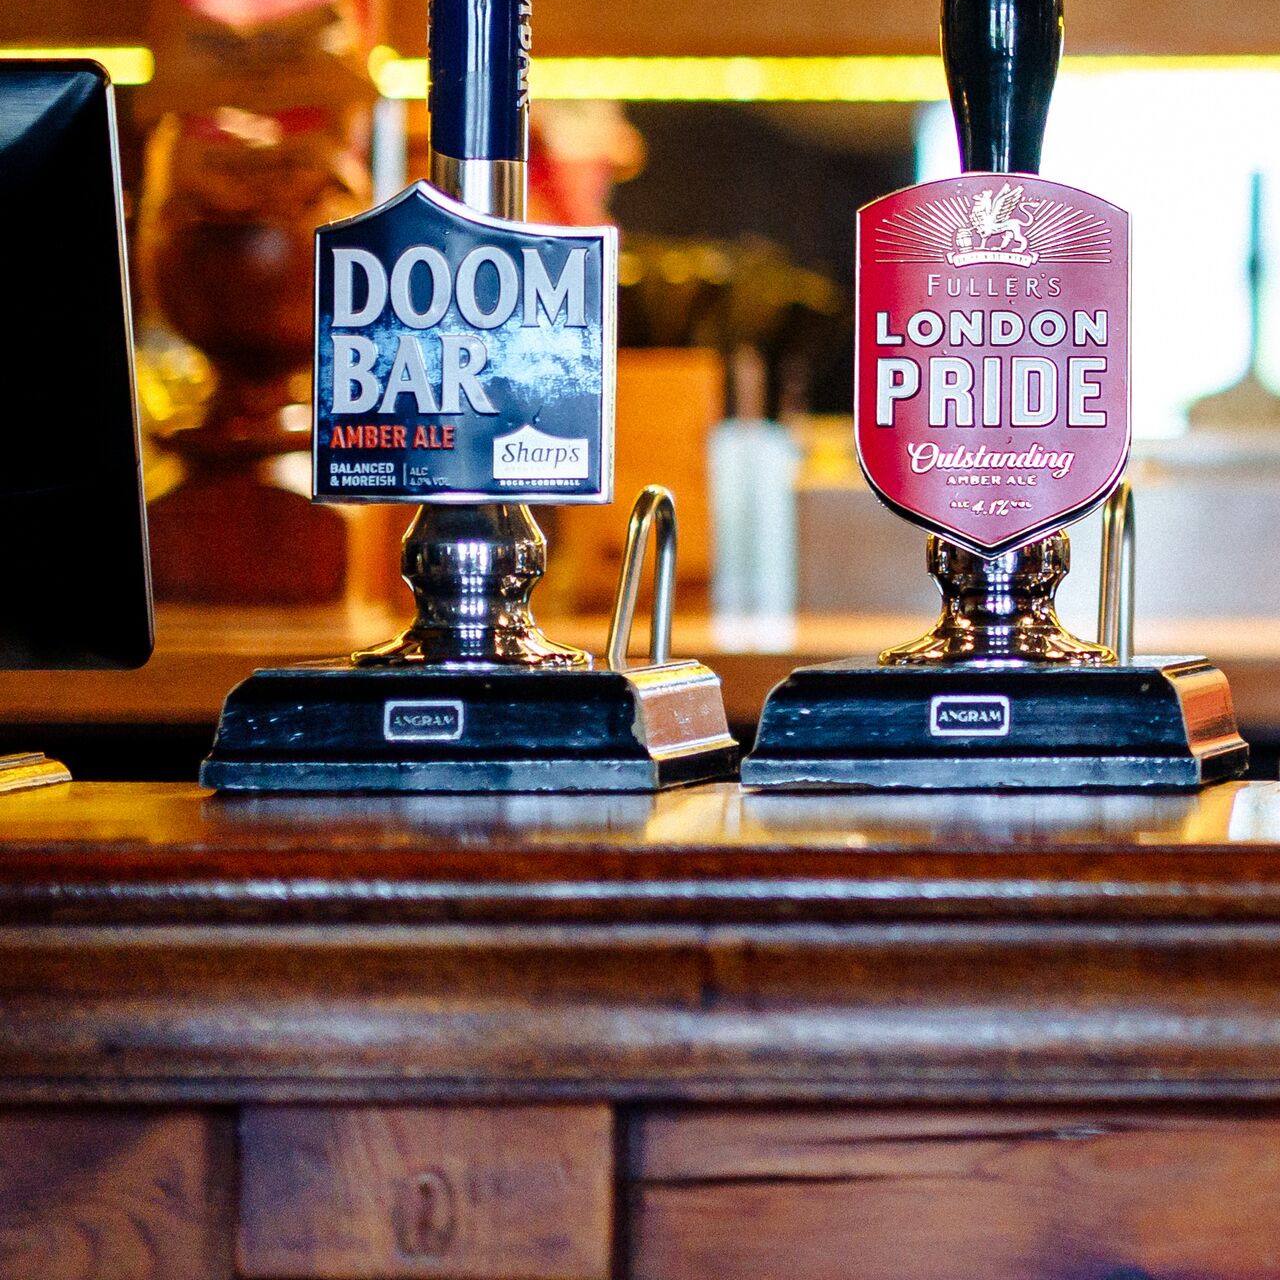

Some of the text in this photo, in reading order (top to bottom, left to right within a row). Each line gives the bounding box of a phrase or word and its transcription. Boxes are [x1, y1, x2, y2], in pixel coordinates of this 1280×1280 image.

[331, 246, 590, 330] DOOM
[927, 273, 1061, 298] FULLER'S
[876, 310, 1108, 346] LONDON
[330, 335, 500, 415] BAR
[876, 356, 1108, 427] PRIDE
[330, 425, 456, 449] AMBER ALE
[501, 441, 580, 469] Sharp's
[908, 442, 1075, 479] Outstanding
[330, 463, 394, 473] BALANCED
[409, 467, 428, 476] ALC
[947, 475, 1037, 485] AMBER ALE
[330, 476, 396, 486] & MOREISH
[938, 710, 1001, 722] ANGRAM
